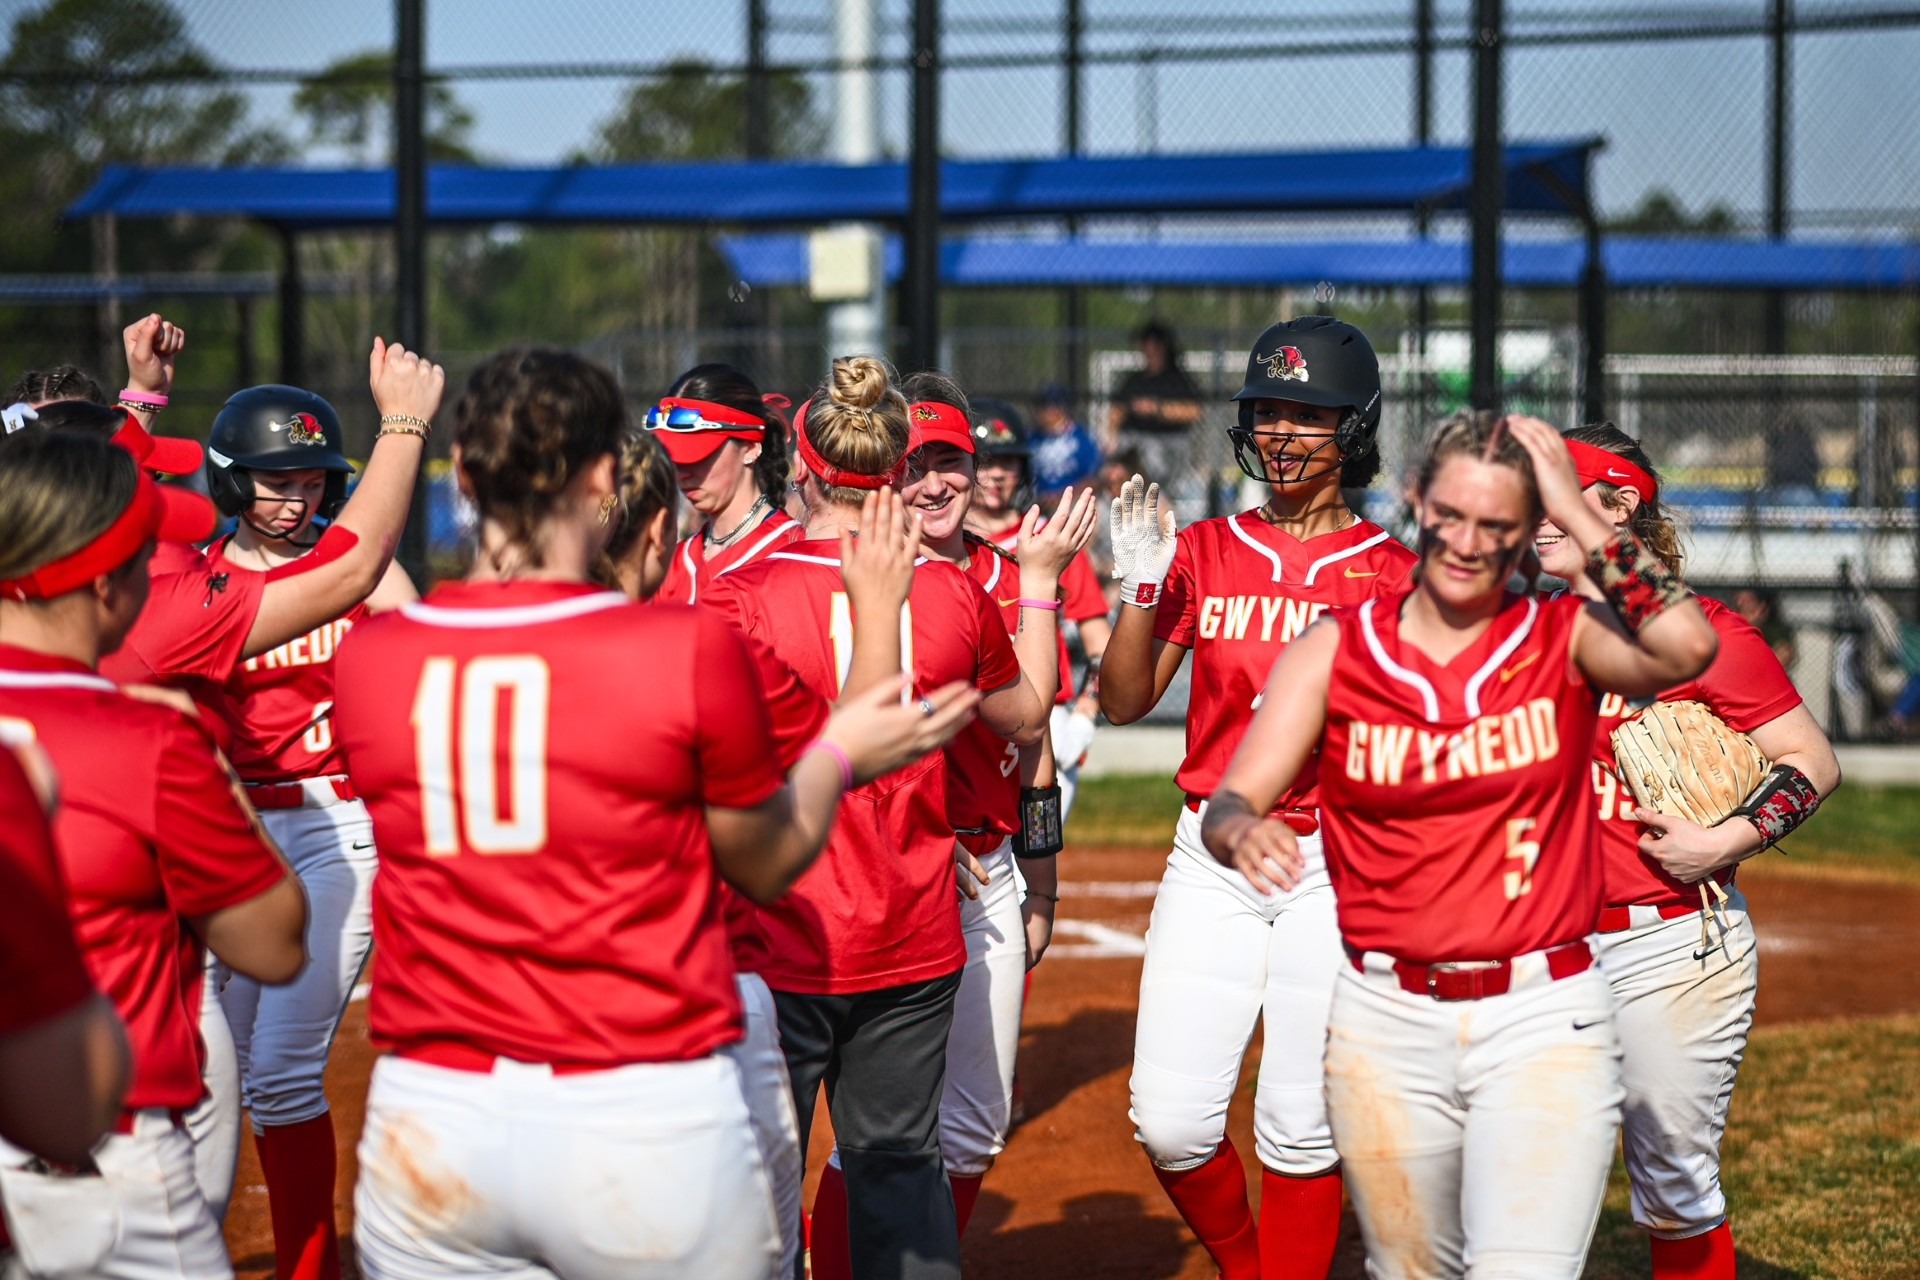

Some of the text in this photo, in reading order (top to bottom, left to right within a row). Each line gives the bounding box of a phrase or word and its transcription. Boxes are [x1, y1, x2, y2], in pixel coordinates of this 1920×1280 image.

[409, 654, 550, 858] 10
[1346, 697, 1559, 786] GWYNEDD
[1503, 817, 1540, 900] 5
